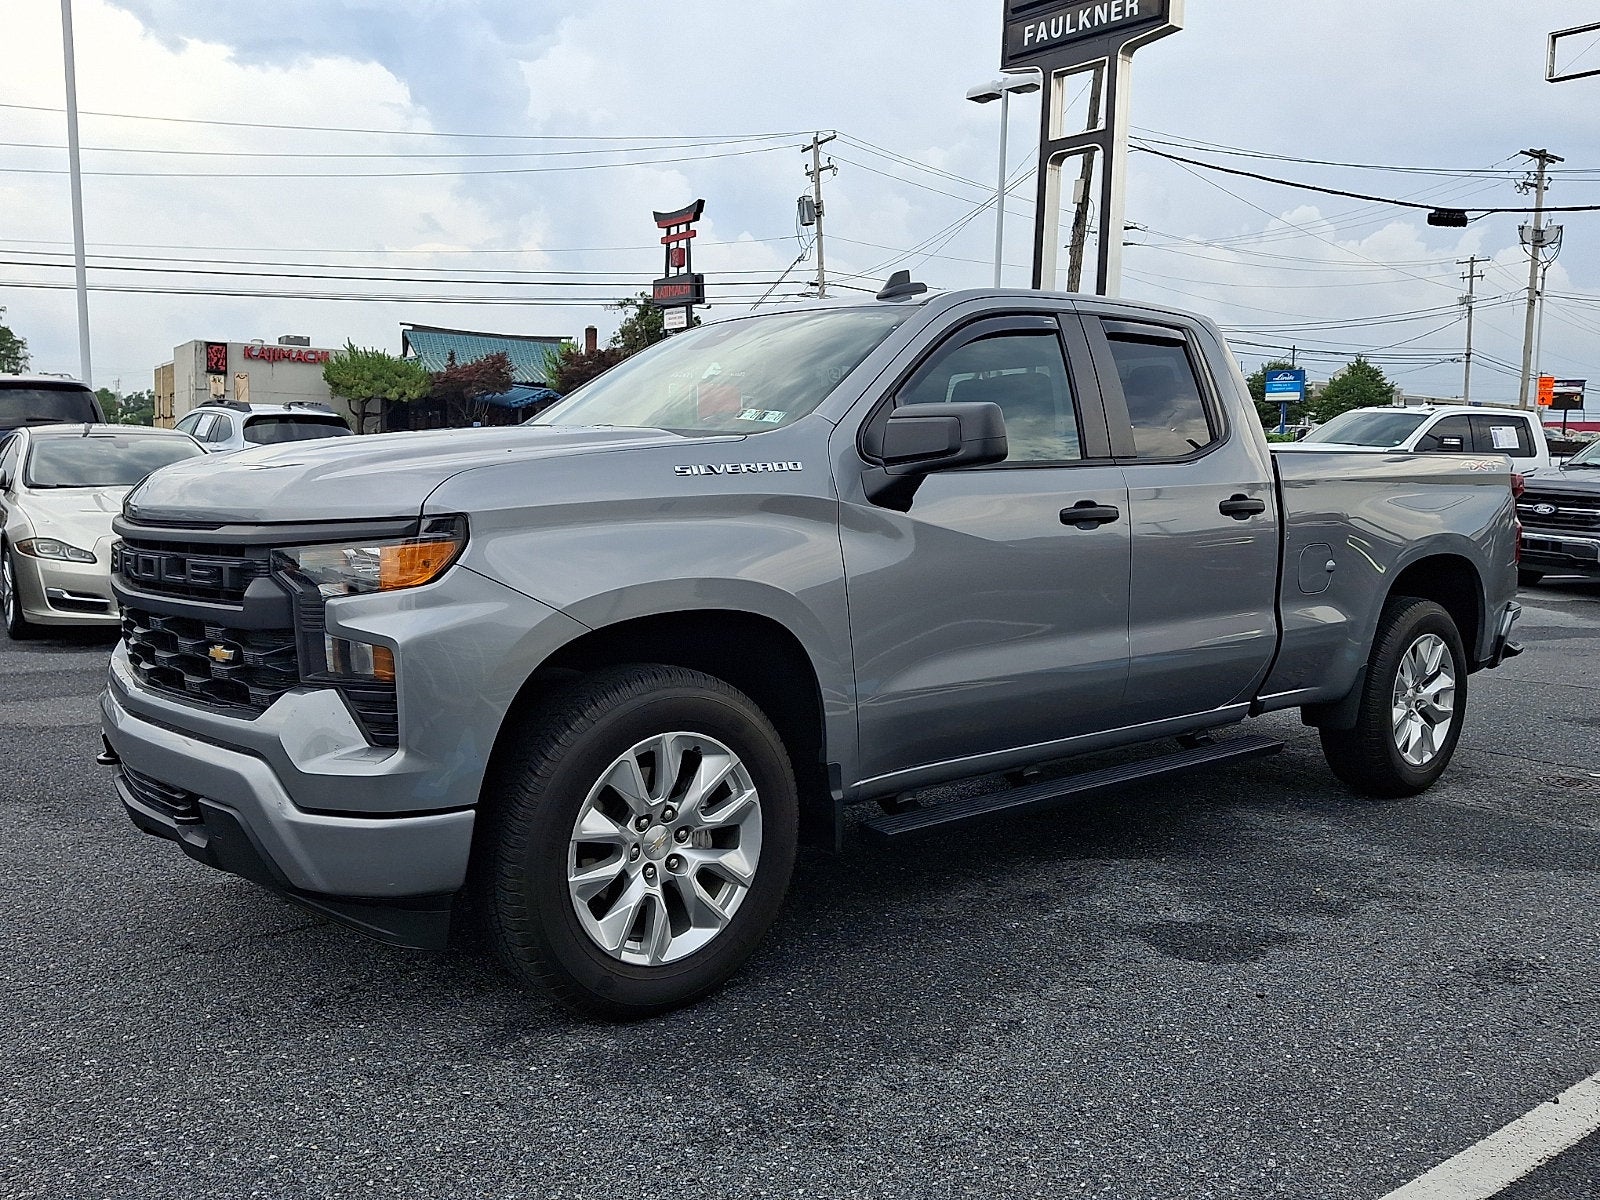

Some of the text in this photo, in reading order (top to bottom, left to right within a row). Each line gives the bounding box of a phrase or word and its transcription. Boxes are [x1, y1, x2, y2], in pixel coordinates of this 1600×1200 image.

[1023, 0, 1139, 46] FAULKNER
[243, 345, 330, 364] KAJIMACHI
[674, 461, 803, 476] SILVERADO
